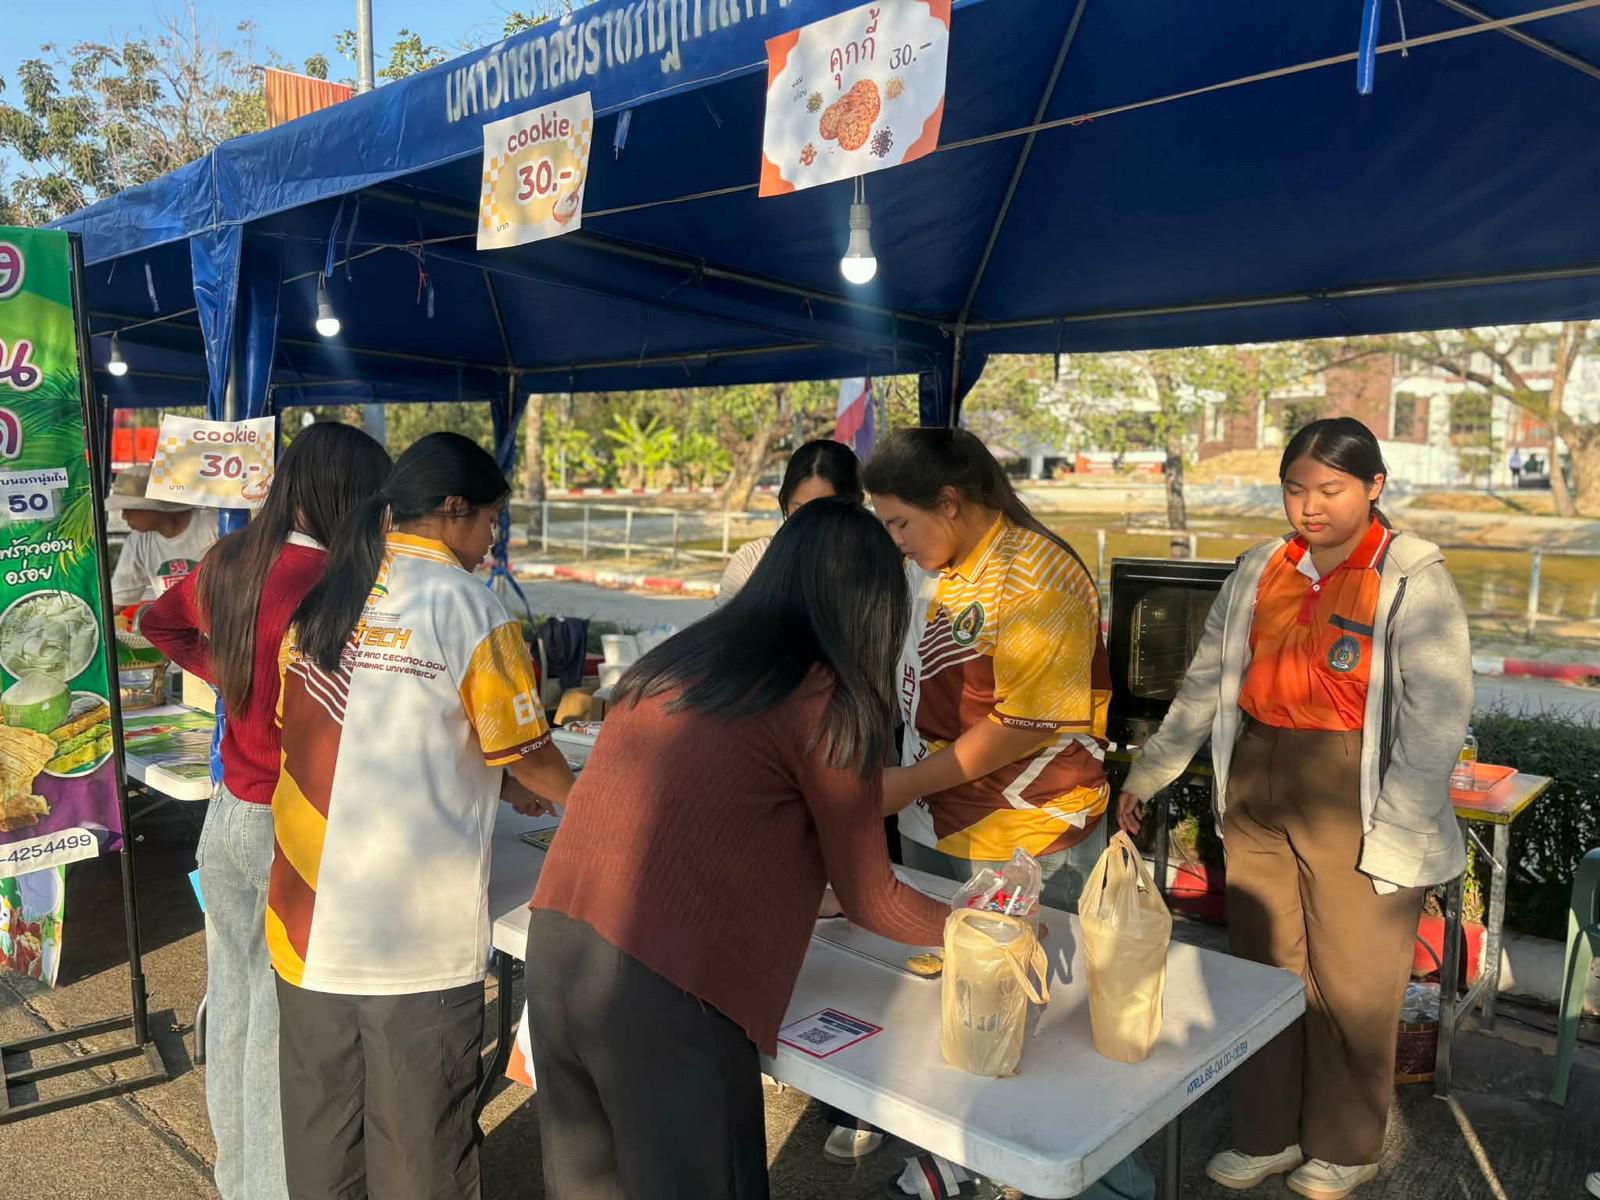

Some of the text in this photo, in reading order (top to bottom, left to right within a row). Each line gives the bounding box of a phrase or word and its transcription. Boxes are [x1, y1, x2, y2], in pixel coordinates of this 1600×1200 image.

[829, 7, 881, 91] คุกกี้
[507, 111, 570, 153] cookie
[518, 160, 573, 201] 30.-
[193, 425, 257, 443] cookie
[200, 454, 260, 479] 30.-
[8, 493, 48, 513] 50
[5, 559, 52, 585] อร่อย
[363, 652, 381, 660] AND
[382, 653, 447, 672] TECHNOLOGY
[385, 664, 437, 680] UNIVERSITY
